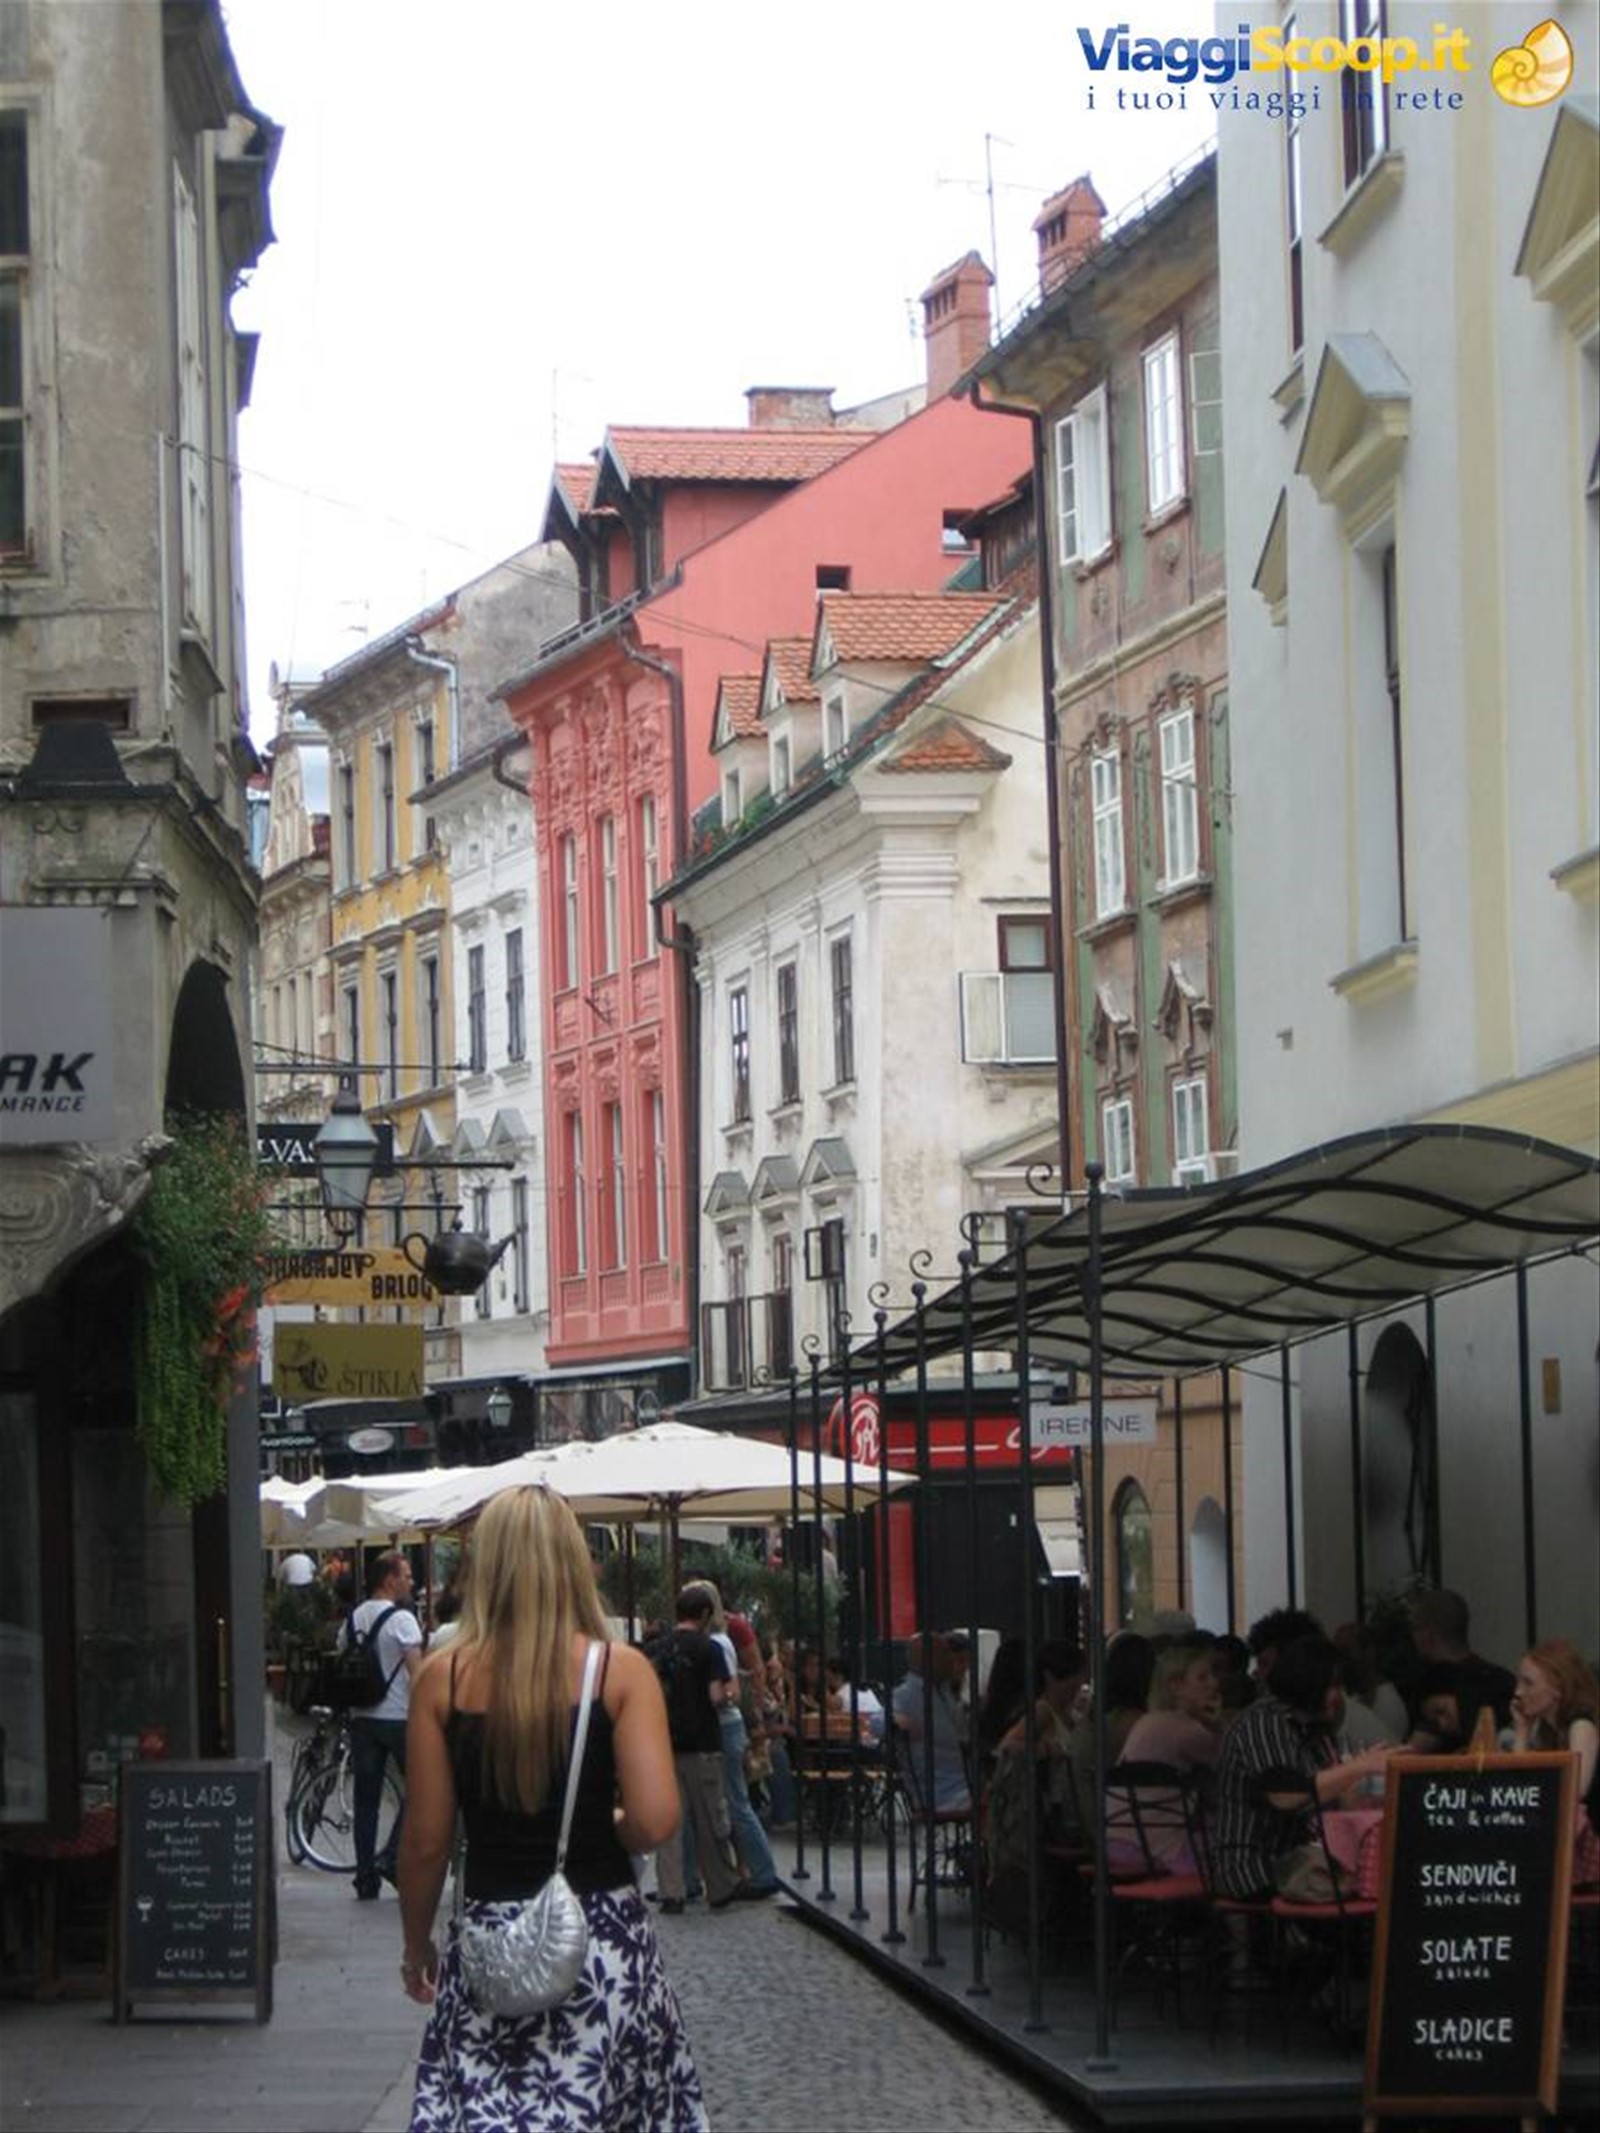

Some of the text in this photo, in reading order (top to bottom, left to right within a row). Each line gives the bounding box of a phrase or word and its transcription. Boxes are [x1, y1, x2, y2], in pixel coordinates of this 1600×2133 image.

[149, 1785, 237, 1809] SALADS
[1423, 1783, 1540, 1810] ČAJI in KAVE
[1420, 1860, 1517, 1887] SENDVIČI
[1420, 1936, 1512, 1965] SOLATE
[1414, 2017, 1513, 2044] SLADICE
